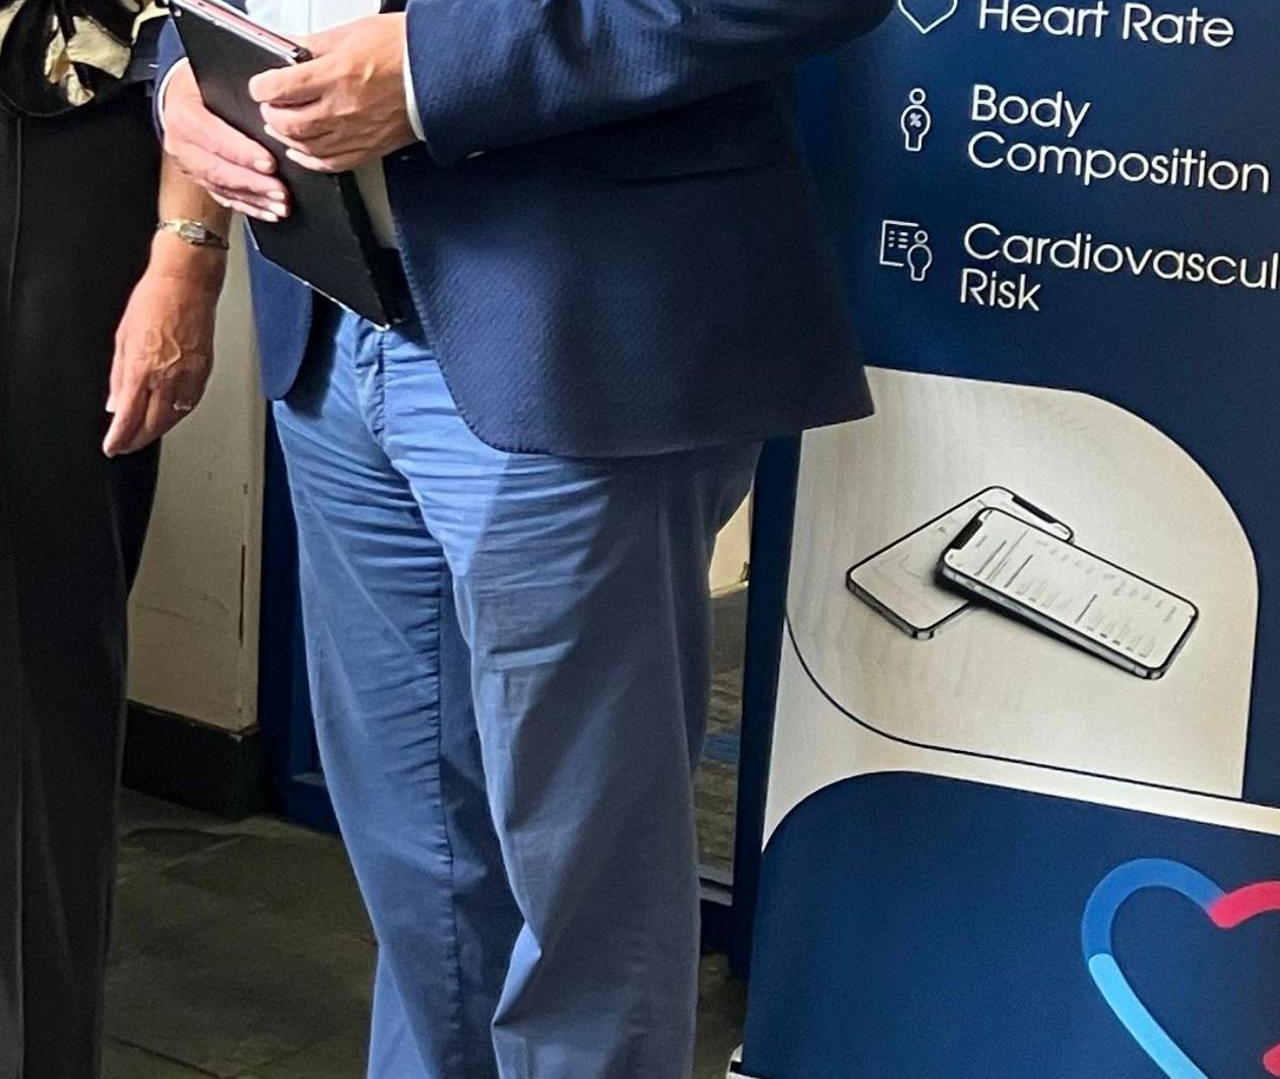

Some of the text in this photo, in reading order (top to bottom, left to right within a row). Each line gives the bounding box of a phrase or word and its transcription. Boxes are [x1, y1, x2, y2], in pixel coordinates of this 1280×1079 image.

[1122, 2, 1234, 47] Rate
[972, 84, 1091, 136] Body
[968, 131, 1269, 193] Composition
[963, 222, 1279, 290] Cardiovascul
[960, 268, 1041, 312] Risk
